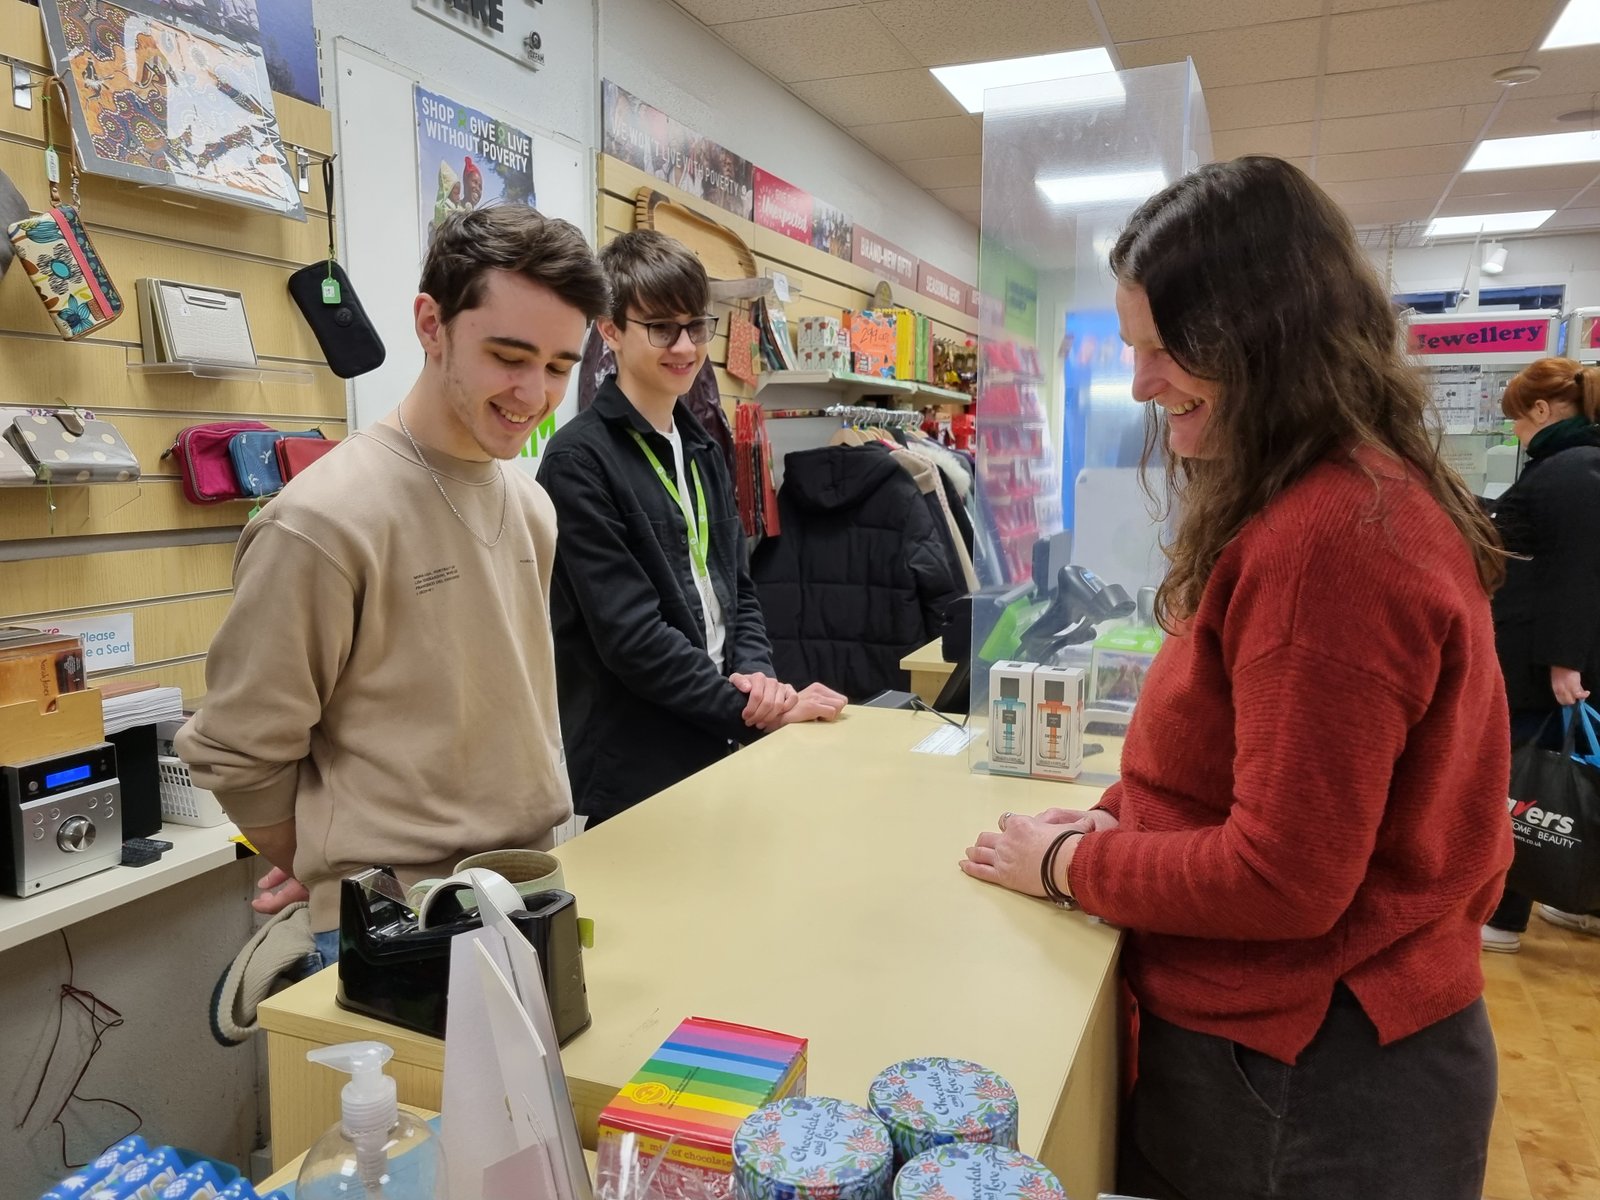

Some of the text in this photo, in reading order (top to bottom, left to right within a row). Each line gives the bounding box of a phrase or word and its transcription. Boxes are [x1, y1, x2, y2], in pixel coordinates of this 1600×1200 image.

[422, 96, 530, 156] SHOP GIVE LIVE
[425, 118, 528, 173] WITHOUT POVERTY
[662, 143, 681, 168] LIVE
[682, 155, 704, 178] WITH
[705, 167, 740, 195] POVERTY
[860, 236, 897, 270] BRAND-NEW
[1417, 325, 1543, 350] Jewellery
[80, 630, 115, 645] Please
[106, 642, 130, 655] Seat
[1537, 831, 1574, 849] BEAUTY
[926, 1070, 949, 1115] Chocolate
[944, 1077, 964, 1095] Love
[791, 1112, 821, 1163] Chocolate
[815, 1121, 838, 1142] Love
[672, 1149, 682, 1159] of
[982, 1171, 1007, 1193] Love
